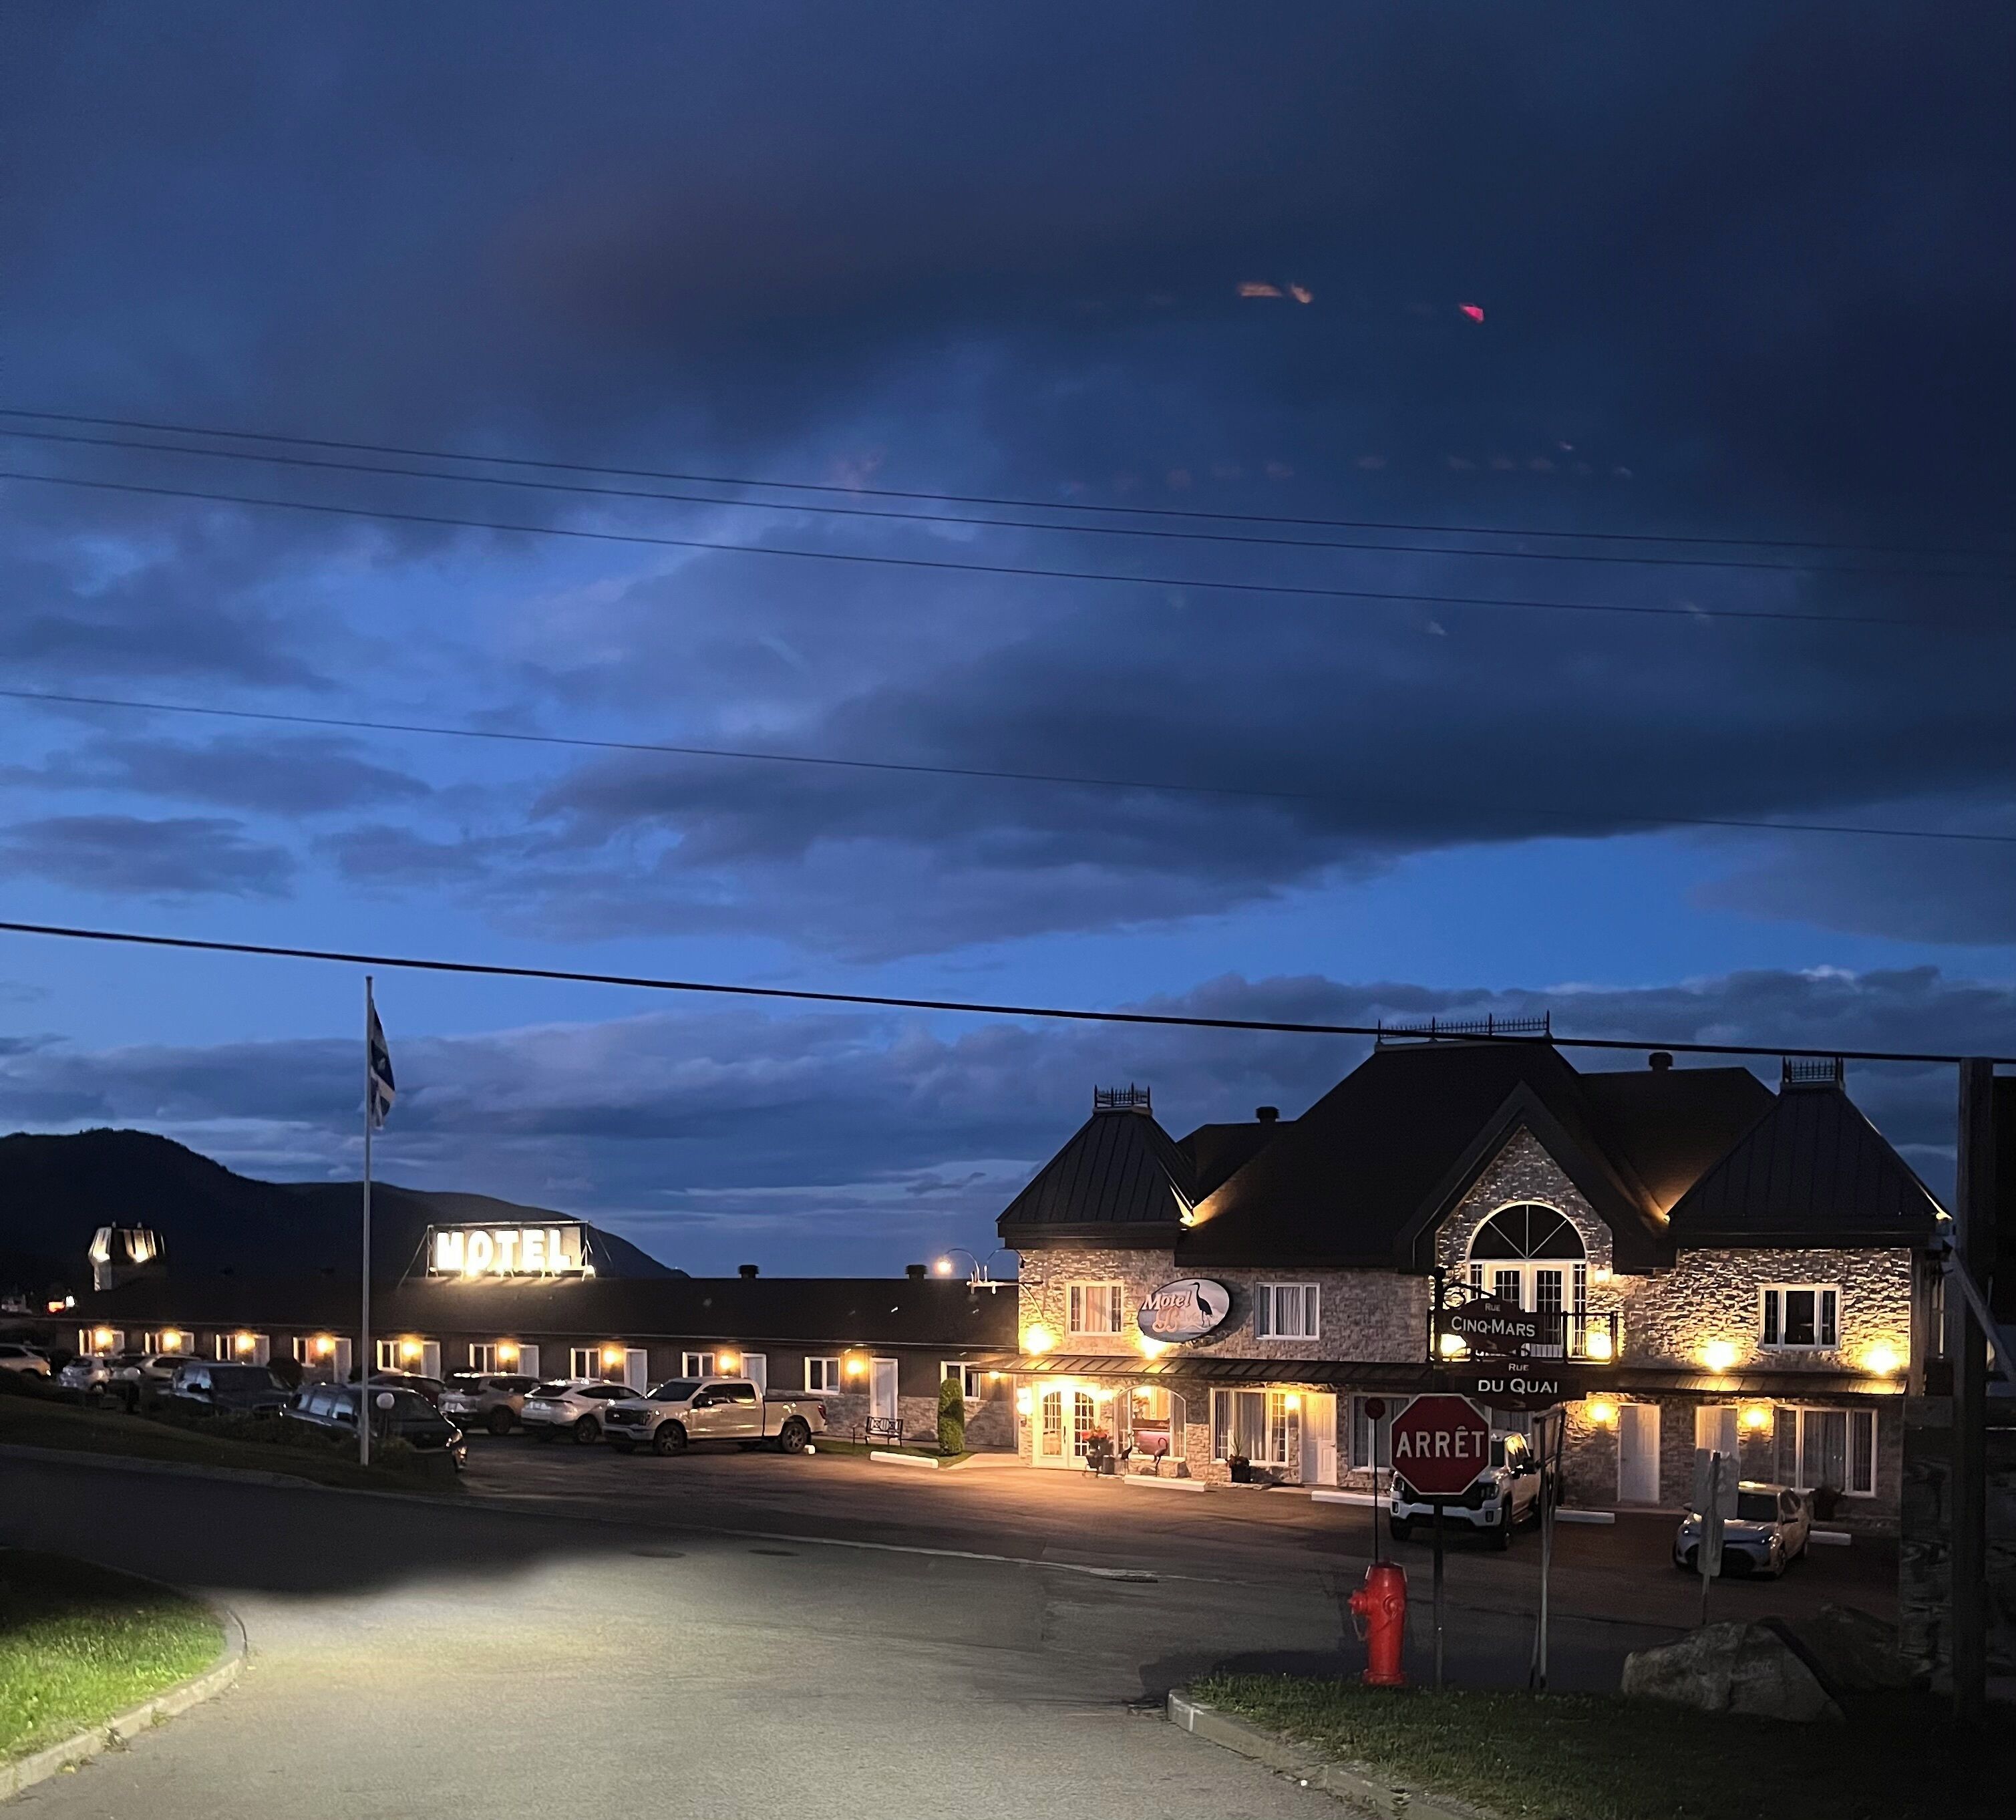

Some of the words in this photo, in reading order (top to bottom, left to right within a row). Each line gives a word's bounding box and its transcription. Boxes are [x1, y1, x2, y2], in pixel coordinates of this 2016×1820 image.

[437, 1229, 572, 1270] MOTEL
[1142, 1290, 1192, 1310] Motel
[1451, 1316, 1536, 1337] CINQ-MARS
[1478, 1380, 1504, 1392] DU
[1510, 1378, 1558, 1395] QUAI
[1396, 1425, 1486, 1458] ARRÊT
